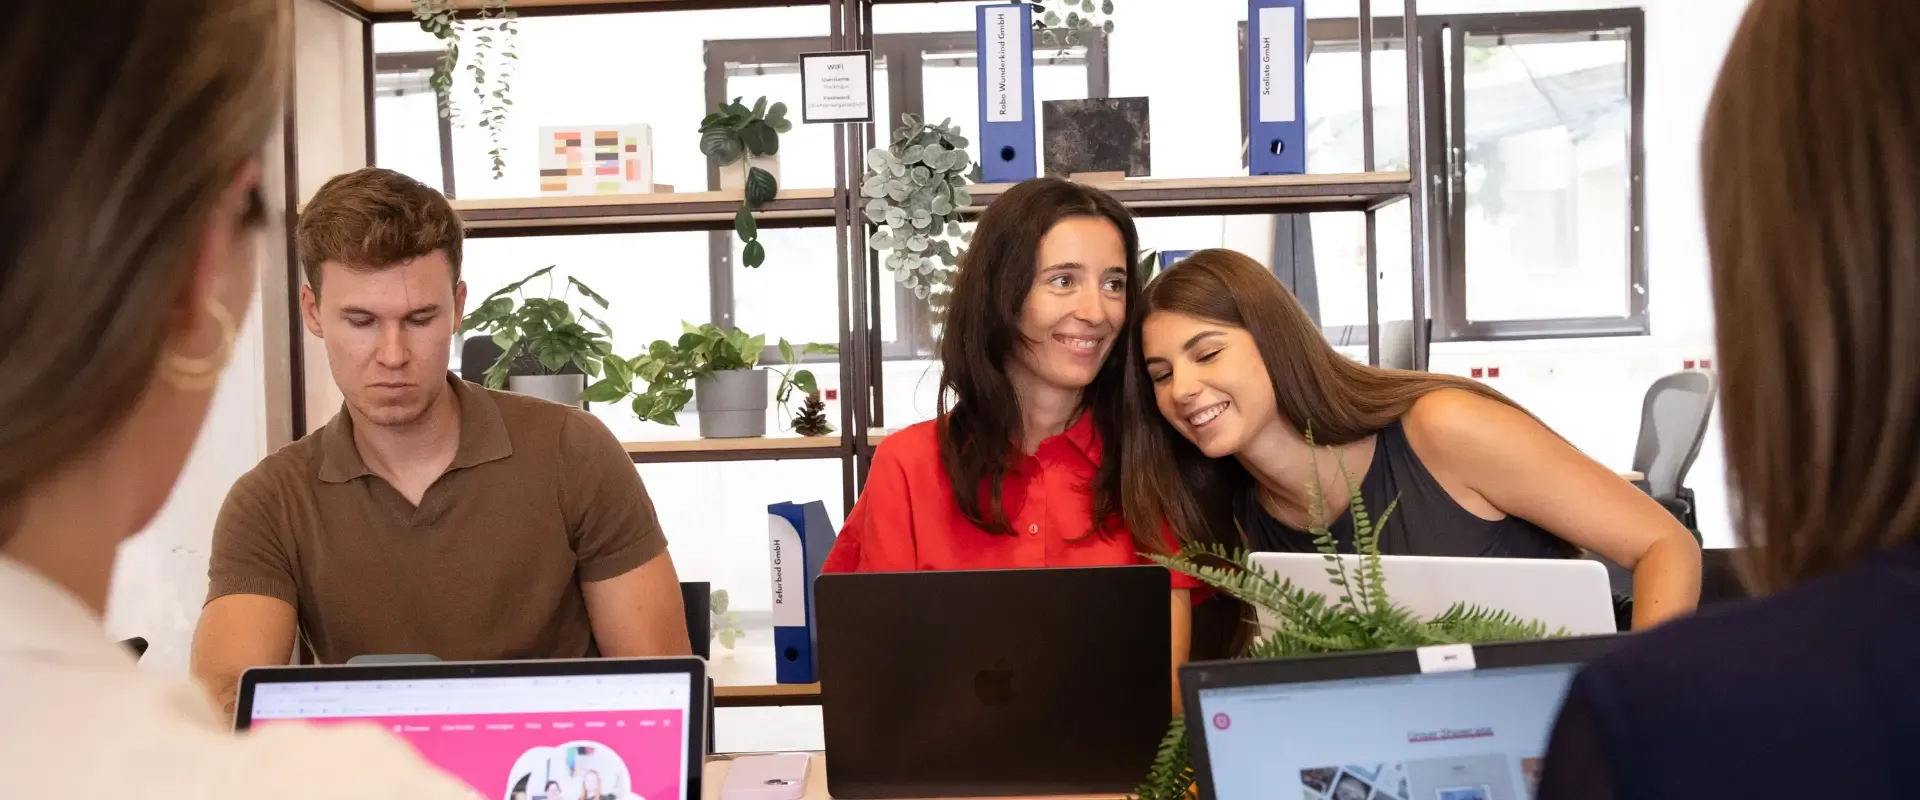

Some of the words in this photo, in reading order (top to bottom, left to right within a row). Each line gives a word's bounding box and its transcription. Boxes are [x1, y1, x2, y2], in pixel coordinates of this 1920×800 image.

[997, 13, 1005, 40] GmbH
[827, 63, 844, 71] WIFI
[998, 41, 1006, 92] Wunderkind
[999, 94, 1007, 115] Robo
[773, 539, 781, 565] GmbH
[774, 567, 783, 604] Refurbed
